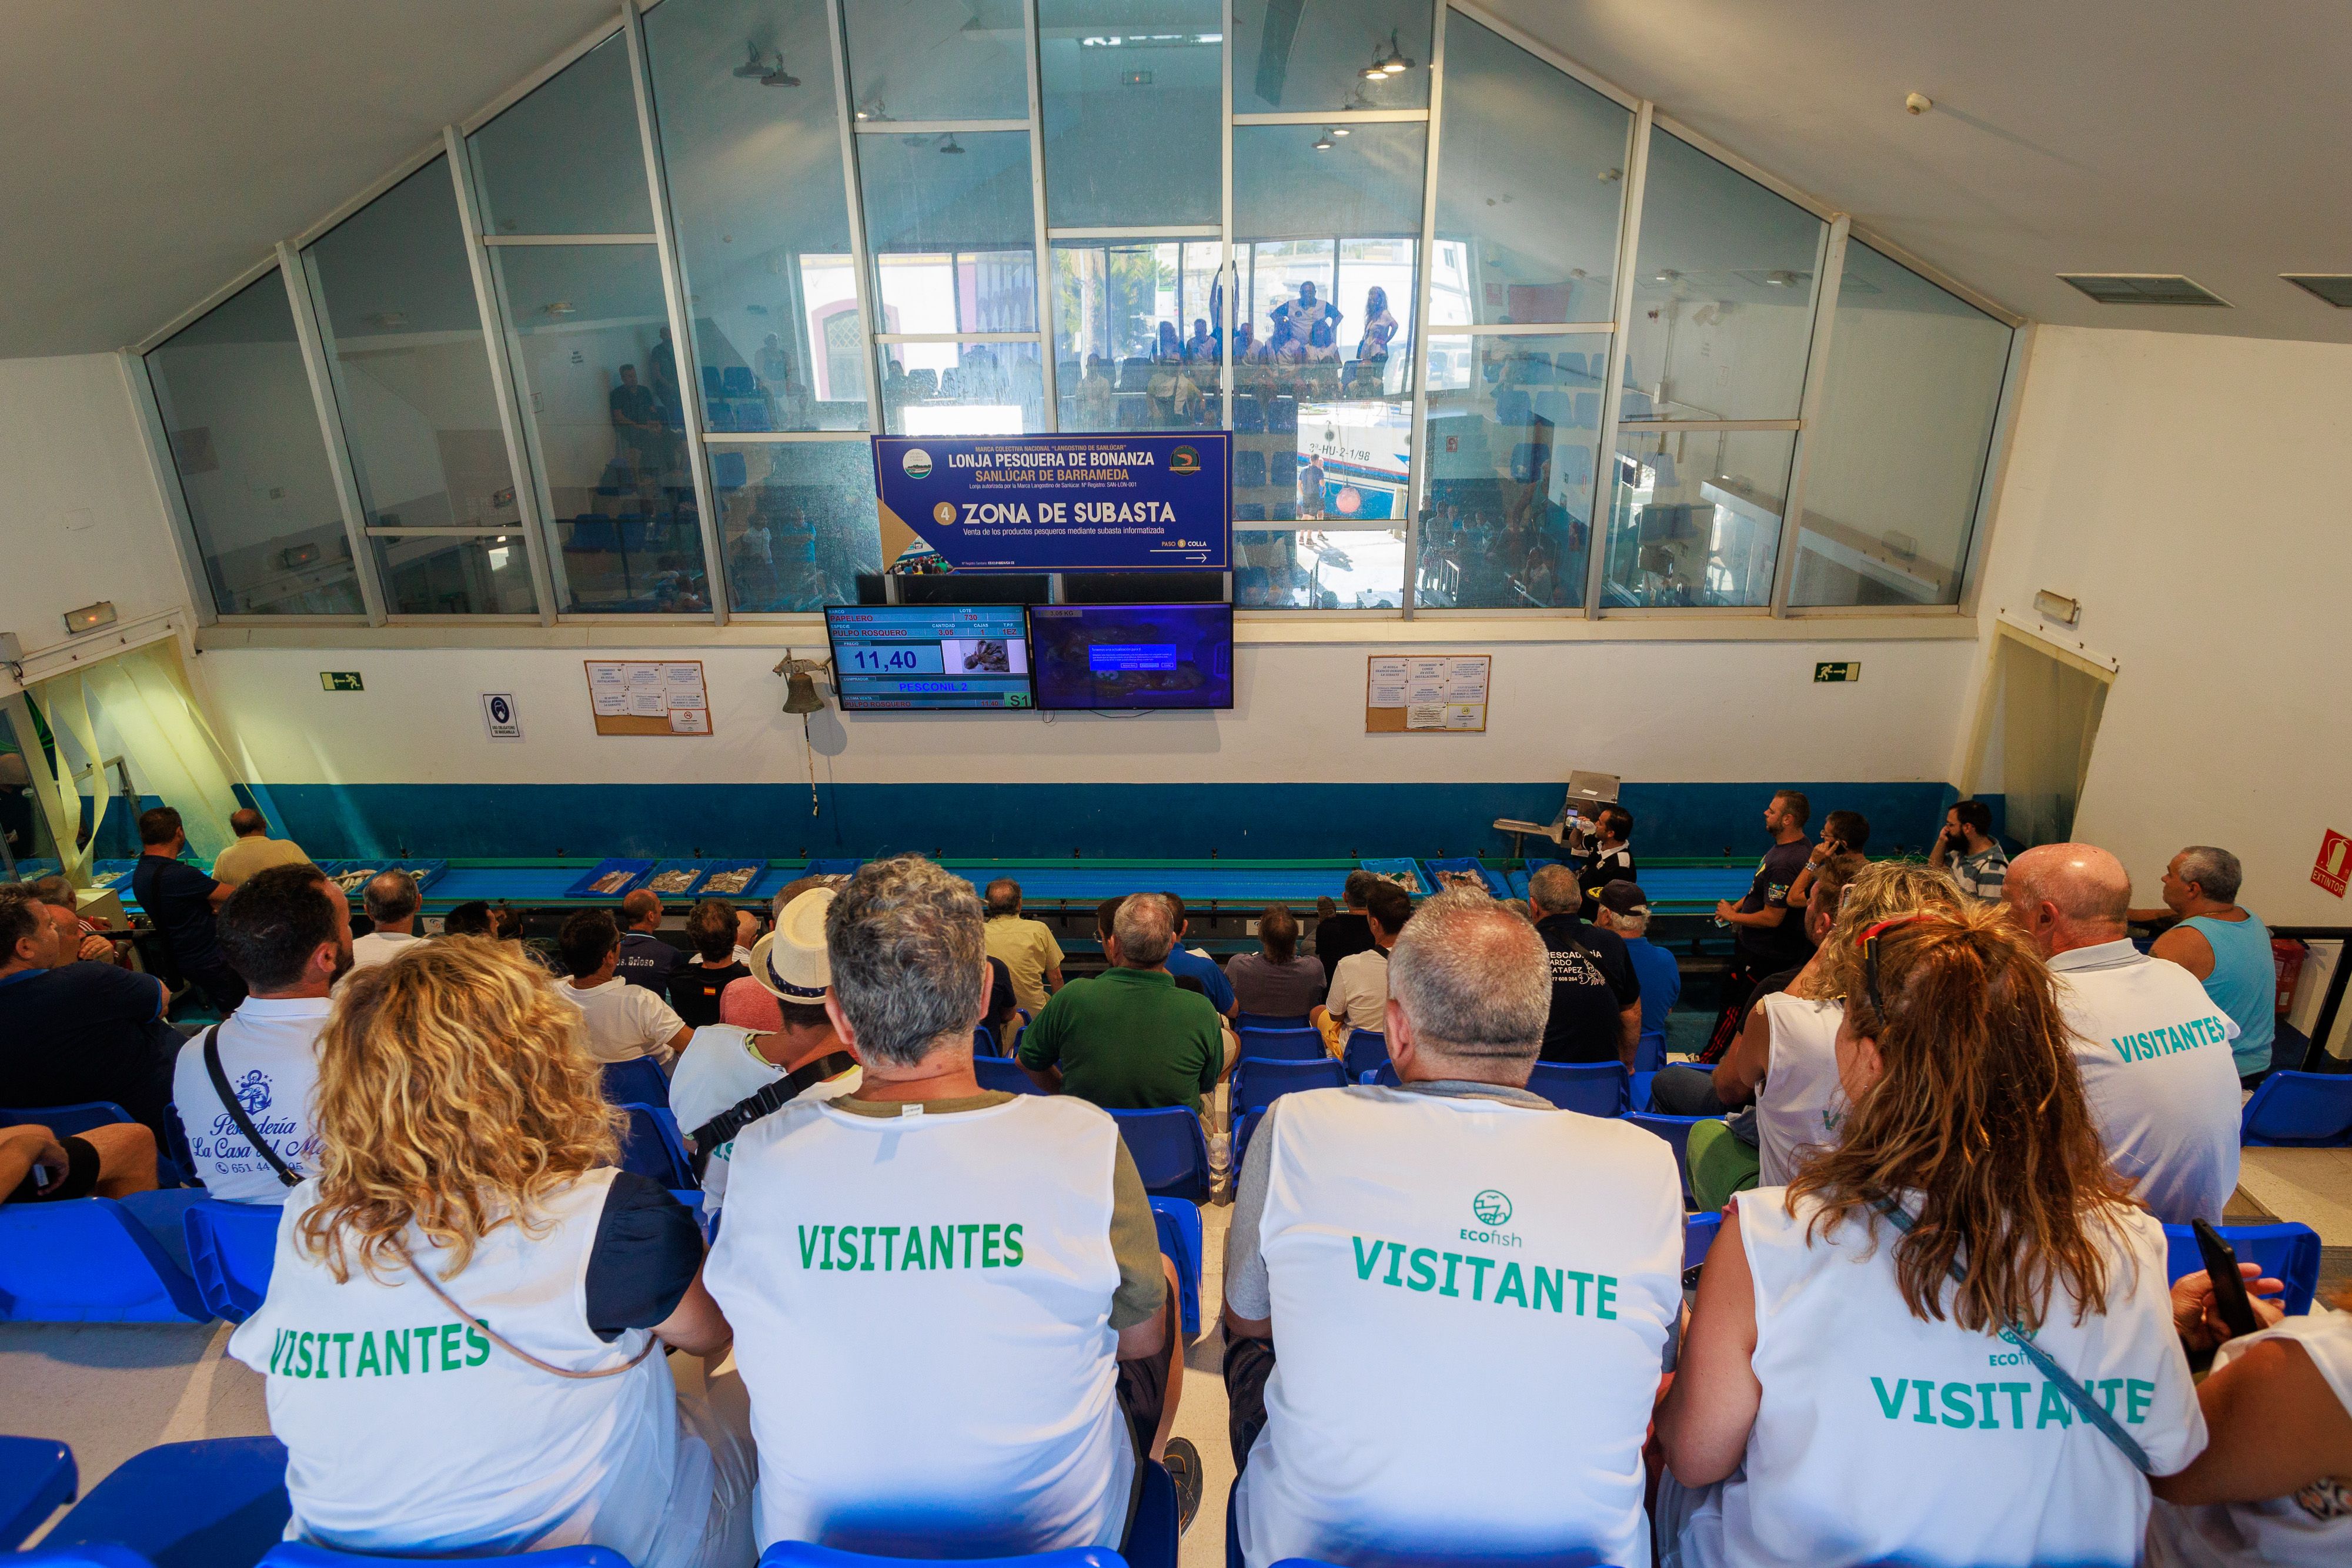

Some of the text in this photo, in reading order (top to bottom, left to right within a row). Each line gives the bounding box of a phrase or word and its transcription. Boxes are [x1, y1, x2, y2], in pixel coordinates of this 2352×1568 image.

[948, 452, 1154, 468] LONJA PESQUERA DE BONANZA
[975, 467, 1129, 482] SANLÚCAR DE BARRAMEDA
[941, 502, 1176, 524] 4 ZONA DE SUBASTA
[1002, 528, 1033, 536] productos
[1034, 528, 1066, 536] pesqueros
[854, 651, 917, 672] 11,40
[899, 682, 968, 692] PESCONIL 2
[1010, 695, 1028, 707] S1
[2312, 870, 2344, 895] EXTINTOR
[628, 957, 654, 967] Brioso
[1548, 950, 1602, 958] ESCADÍA
[2111, 1015, 2225, 1064] VISITANTES
[209, 1113, 297, 1136] Pesdería
[192, 1137, 212, 1158] La
[215, 1138, 252, 1159] Casa
[256, 1139, 280, 1158] dl
[232, 1164, 253, 1174] 651
[798, 1223, 1024, 1271] VISITANTES
[1460, 1229, 1522, 1248] ECOfish
[1352, 1236, 1618, 1320] VISITANTE
[270, 1319, 490, 1379] VISITANTES
